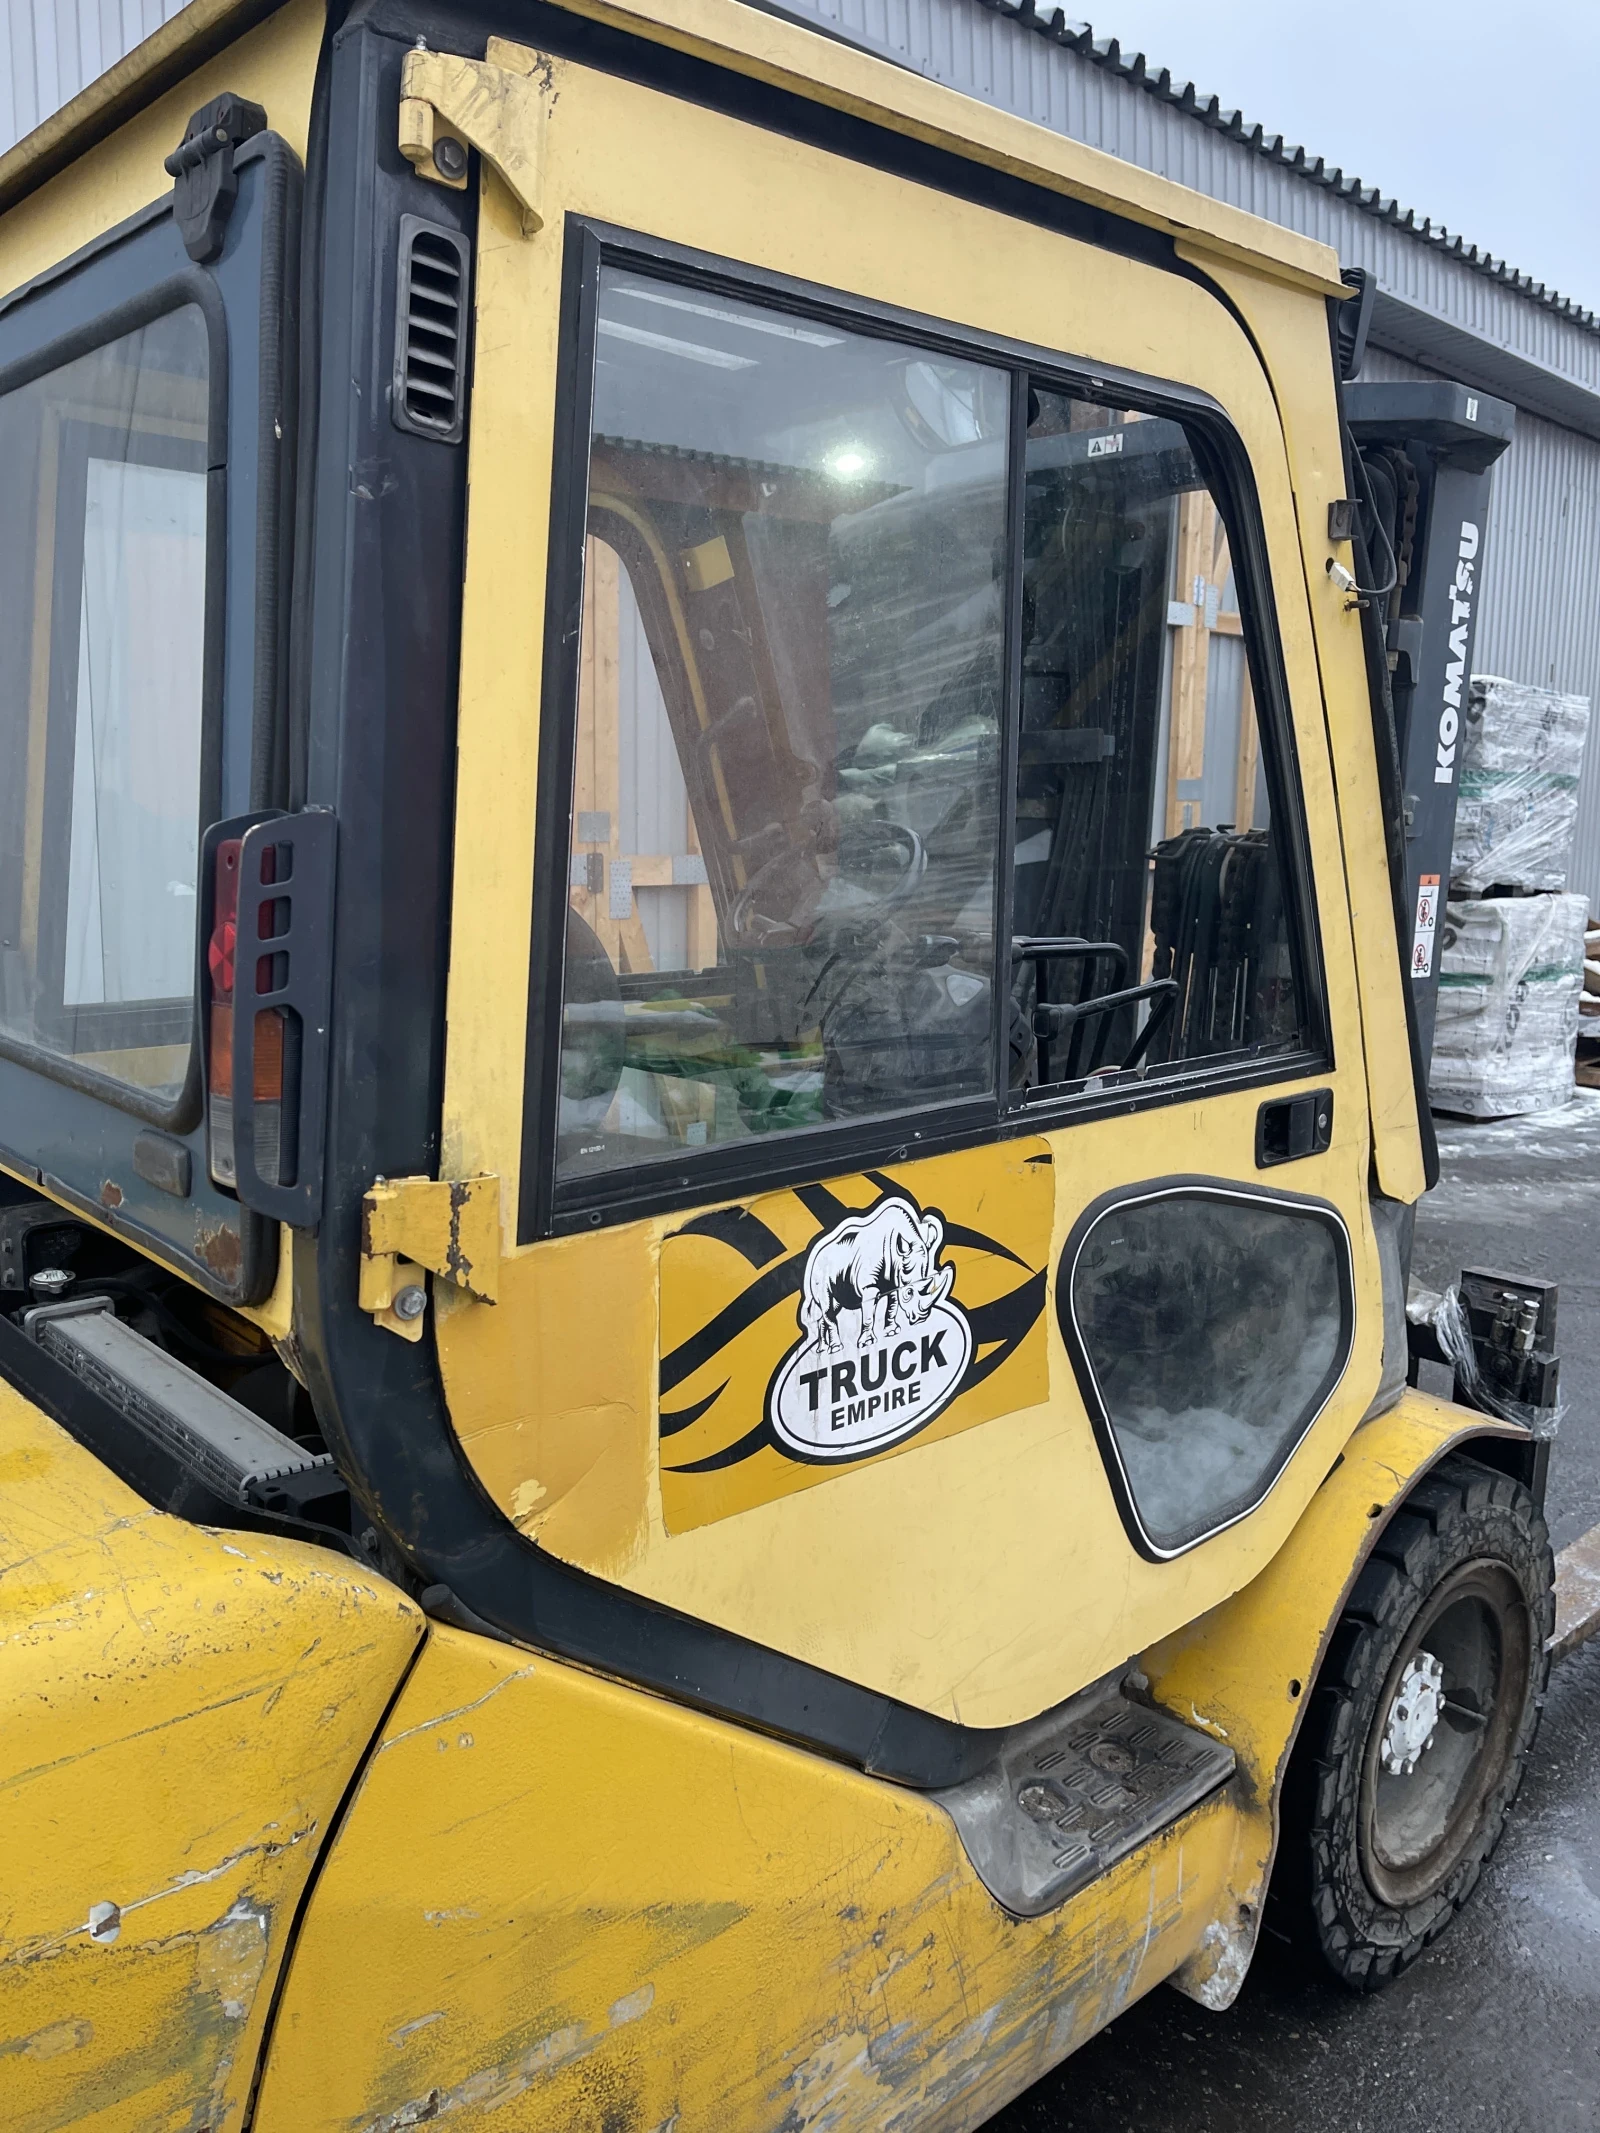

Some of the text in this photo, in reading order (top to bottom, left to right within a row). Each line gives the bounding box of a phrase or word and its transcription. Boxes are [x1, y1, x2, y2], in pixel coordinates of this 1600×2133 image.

[1434, 521, 1479, 784] KOMATSU
[800, 1329, 948, 1412] TRUCK
[831, 1381, 921, 1431] EMPIRE
